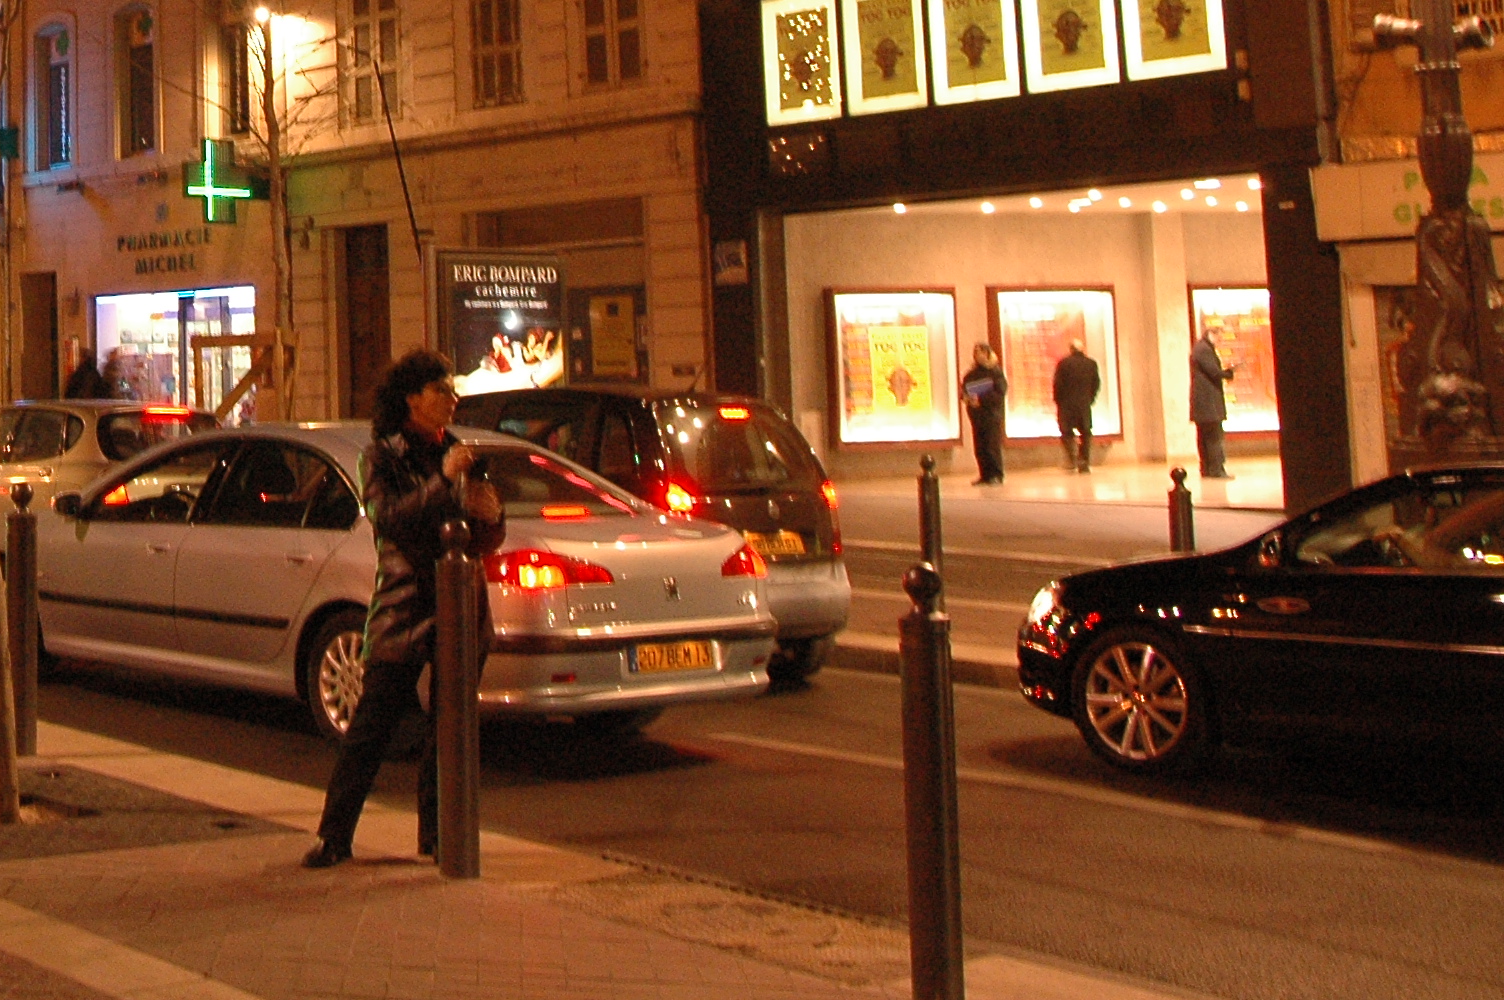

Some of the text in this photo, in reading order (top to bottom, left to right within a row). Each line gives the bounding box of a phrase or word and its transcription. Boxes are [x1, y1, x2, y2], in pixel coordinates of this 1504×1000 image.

[117, 226, 211, 251] PHARMACIE
[135, 253, 195, 275] MICHEL
[453, 264, 557, 284] ERIC BOMPARD
[475, 283, 537, 298] cachemire
